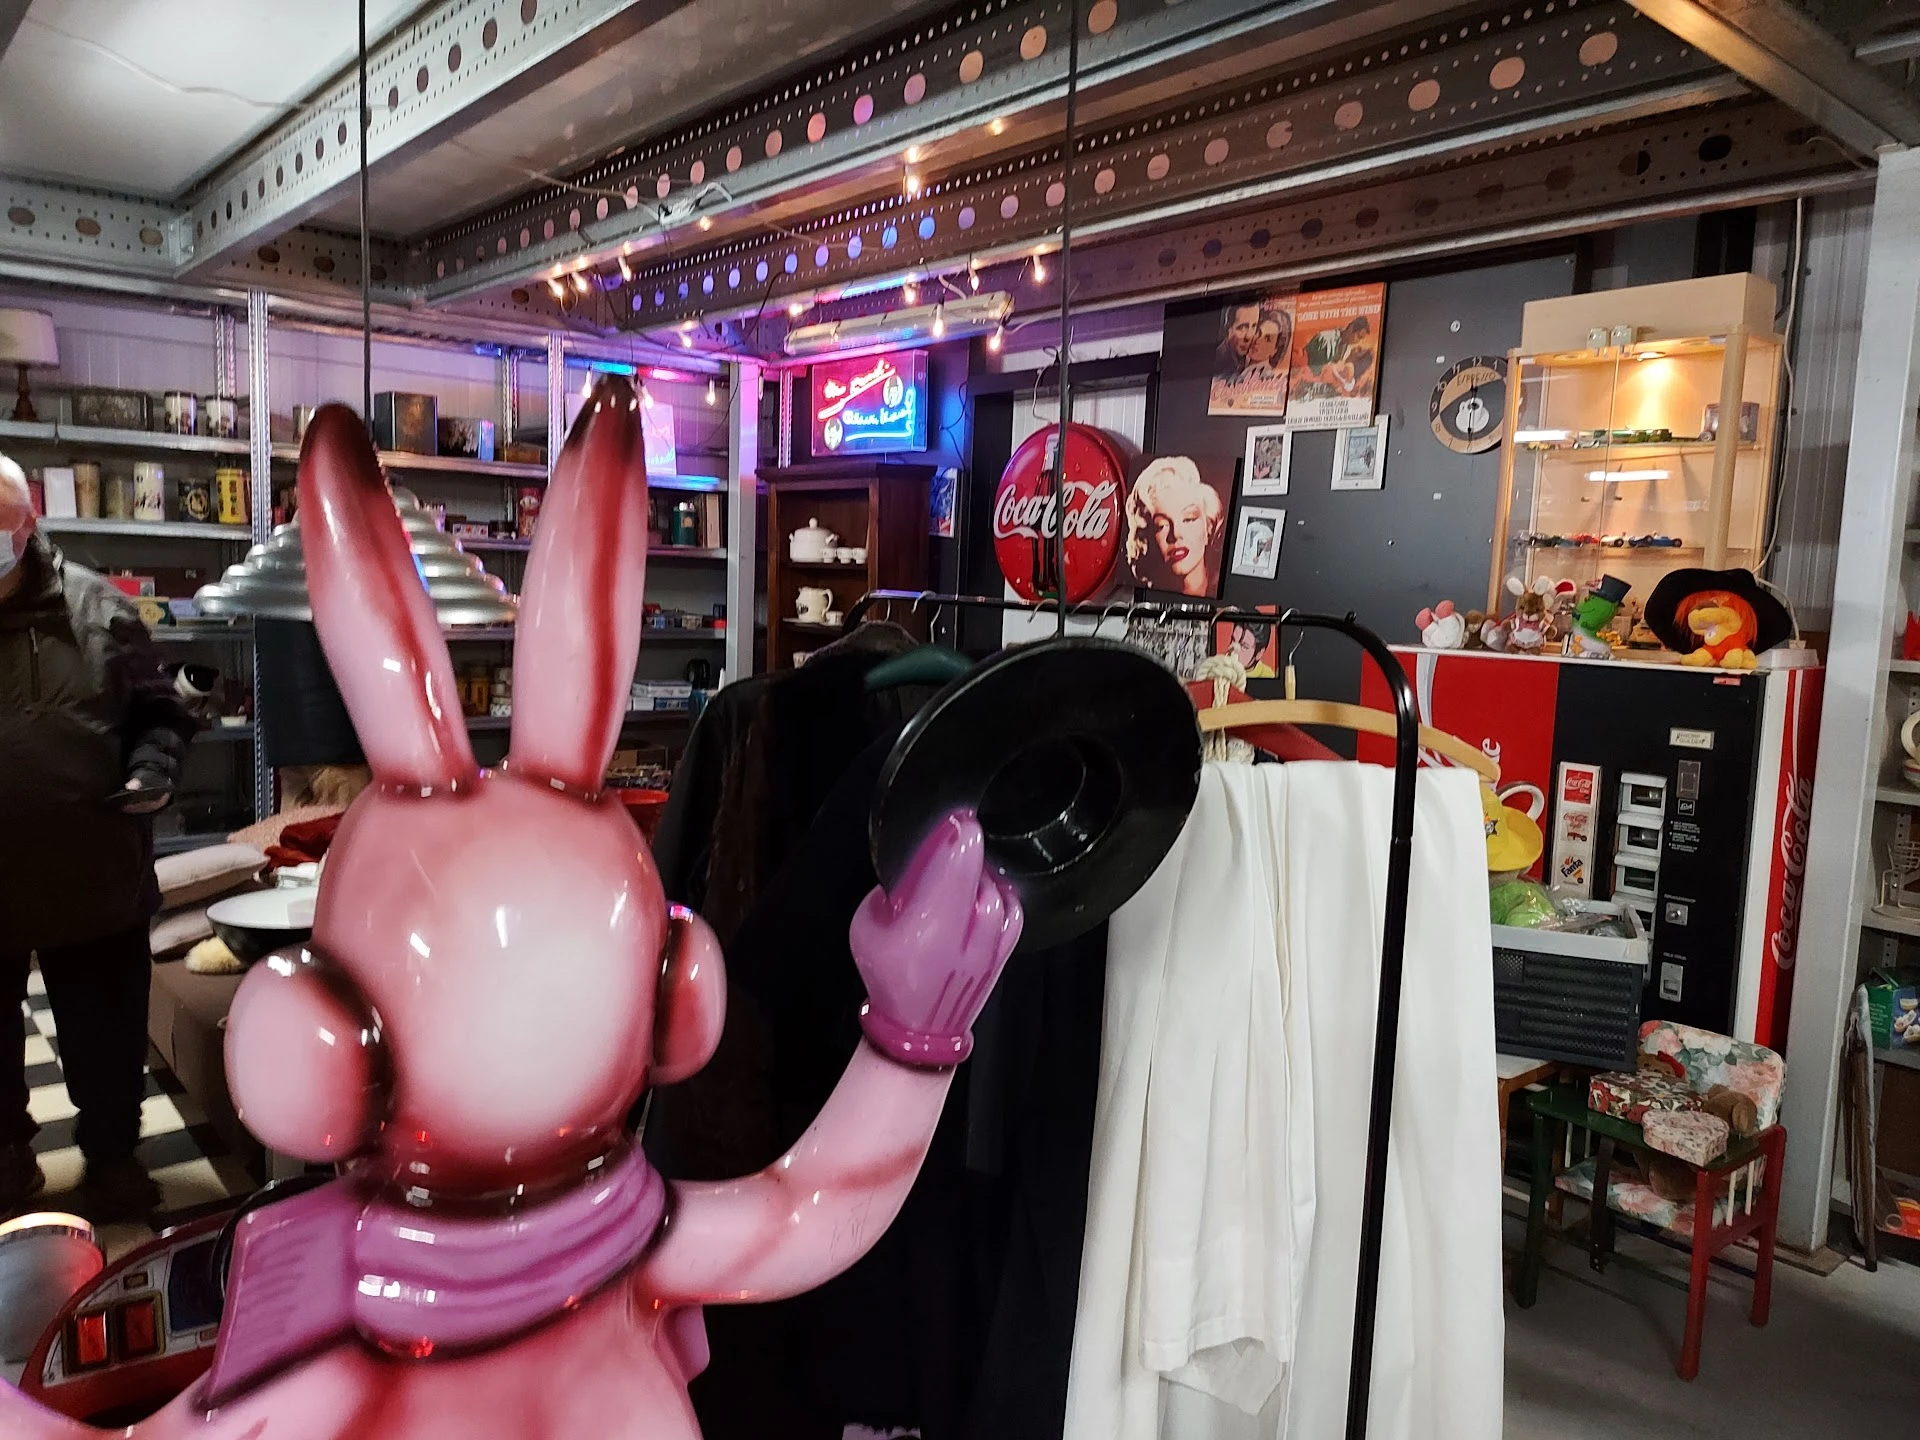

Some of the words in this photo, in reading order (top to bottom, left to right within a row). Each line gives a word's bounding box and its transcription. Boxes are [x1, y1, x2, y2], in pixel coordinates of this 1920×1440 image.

[1320, 308, 1340, 320] WITH
[1340, 306, 1357, 318] THE
[1472, 356, 1482, 367] 12
[1452, 364, 1460, 374] 11
[1437, 381, 1447, 392] 10
[1431, 401, 1438, 412] 9
[993, 479, 1119, 540] Coca-Cola
[1565, 776, 1592, 790] Coca-Cola
[1560, 859, 1583, 878] Fanta
[1772, 773, 1812, 970] Coca-Cola
